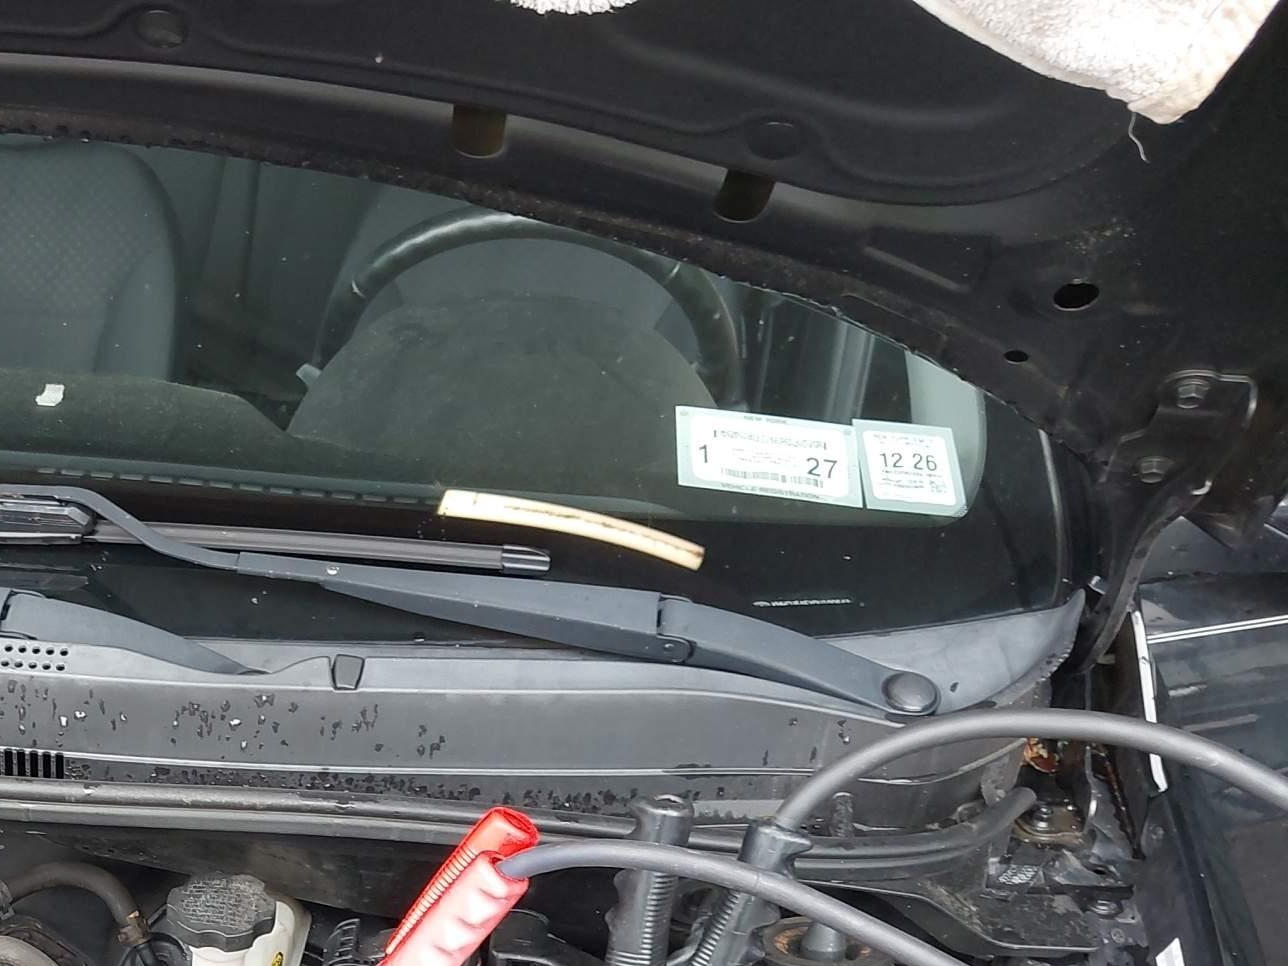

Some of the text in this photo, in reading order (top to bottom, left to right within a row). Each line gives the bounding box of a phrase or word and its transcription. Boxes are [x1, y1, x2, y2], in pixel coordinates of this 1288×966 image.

[698, 444, 708, 464] 1
[880, 452, 937, 471] 12 26
[806, 457, 838, 479] 27
